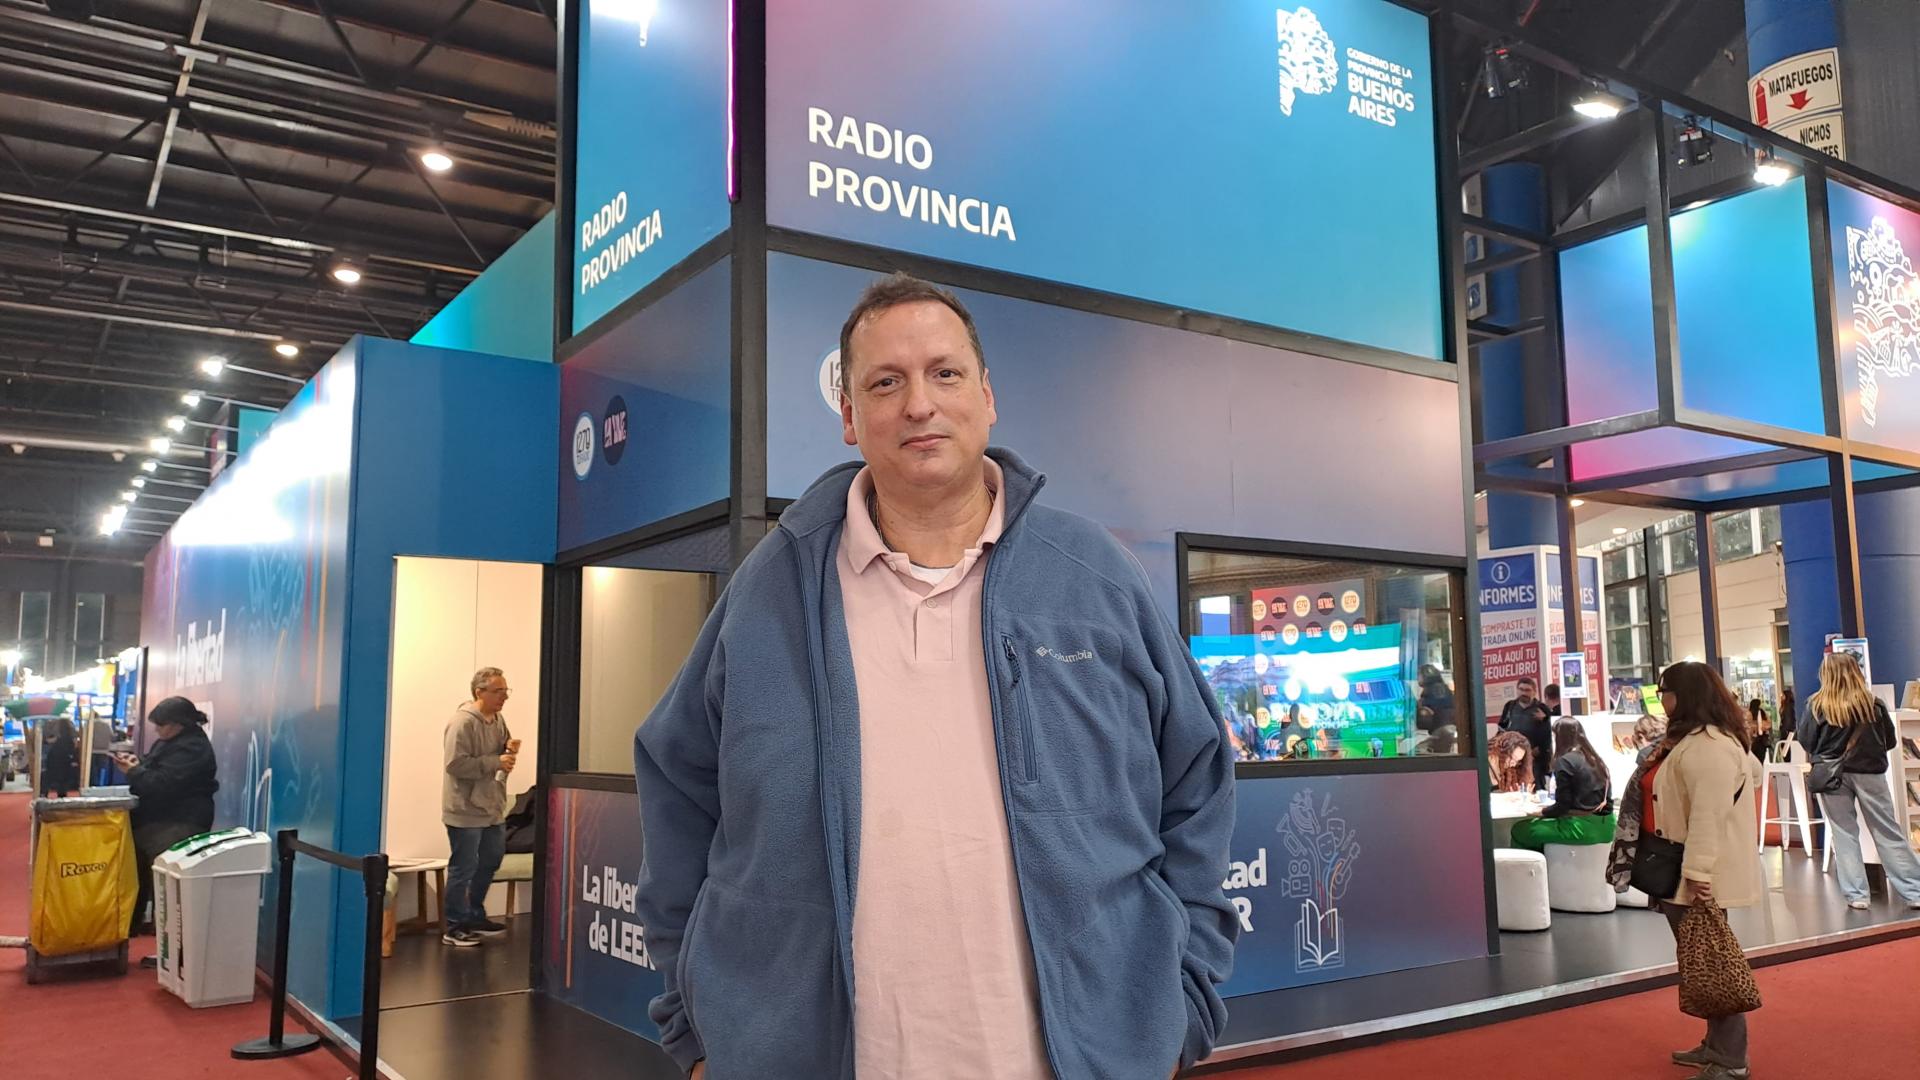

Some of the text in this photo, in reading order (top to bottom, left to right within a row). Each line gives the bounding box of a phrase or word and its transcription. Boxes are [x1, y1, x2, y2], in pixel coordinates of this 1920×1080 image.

[1347, 60, 1404, 88] PROVINCIA DE
[1390, 62, 1402, 75] DE
[1402, 66, 1413, 80] LA
[1769, 63, 1833, 97] MATAFUEGOS
[1348, 72, 1415, 112] BUENOS
[1348, 95, 1397, 127] AIRES
[808, 107, 934, 170] RADIO
[1800, 122, 1831, 145] NICHOS
[809, 161, 1017, 241] PROVINCIA
[582, 191, 627, 252] RADIO
[582, 209, 662, 295] PROVINCIA
[1480, 585, 1535, 606] NFORMES
[1482, 629, 1537, 646] TRADA ONLINE
[1526, 647, 1537, 660] TU
[1048, 648, 1093, 663] Columbia
[1483, 660, 1538, 679] HEQUELIBRO
[583, 865, 600, 905] La
[589, 910, 608, 954] de
